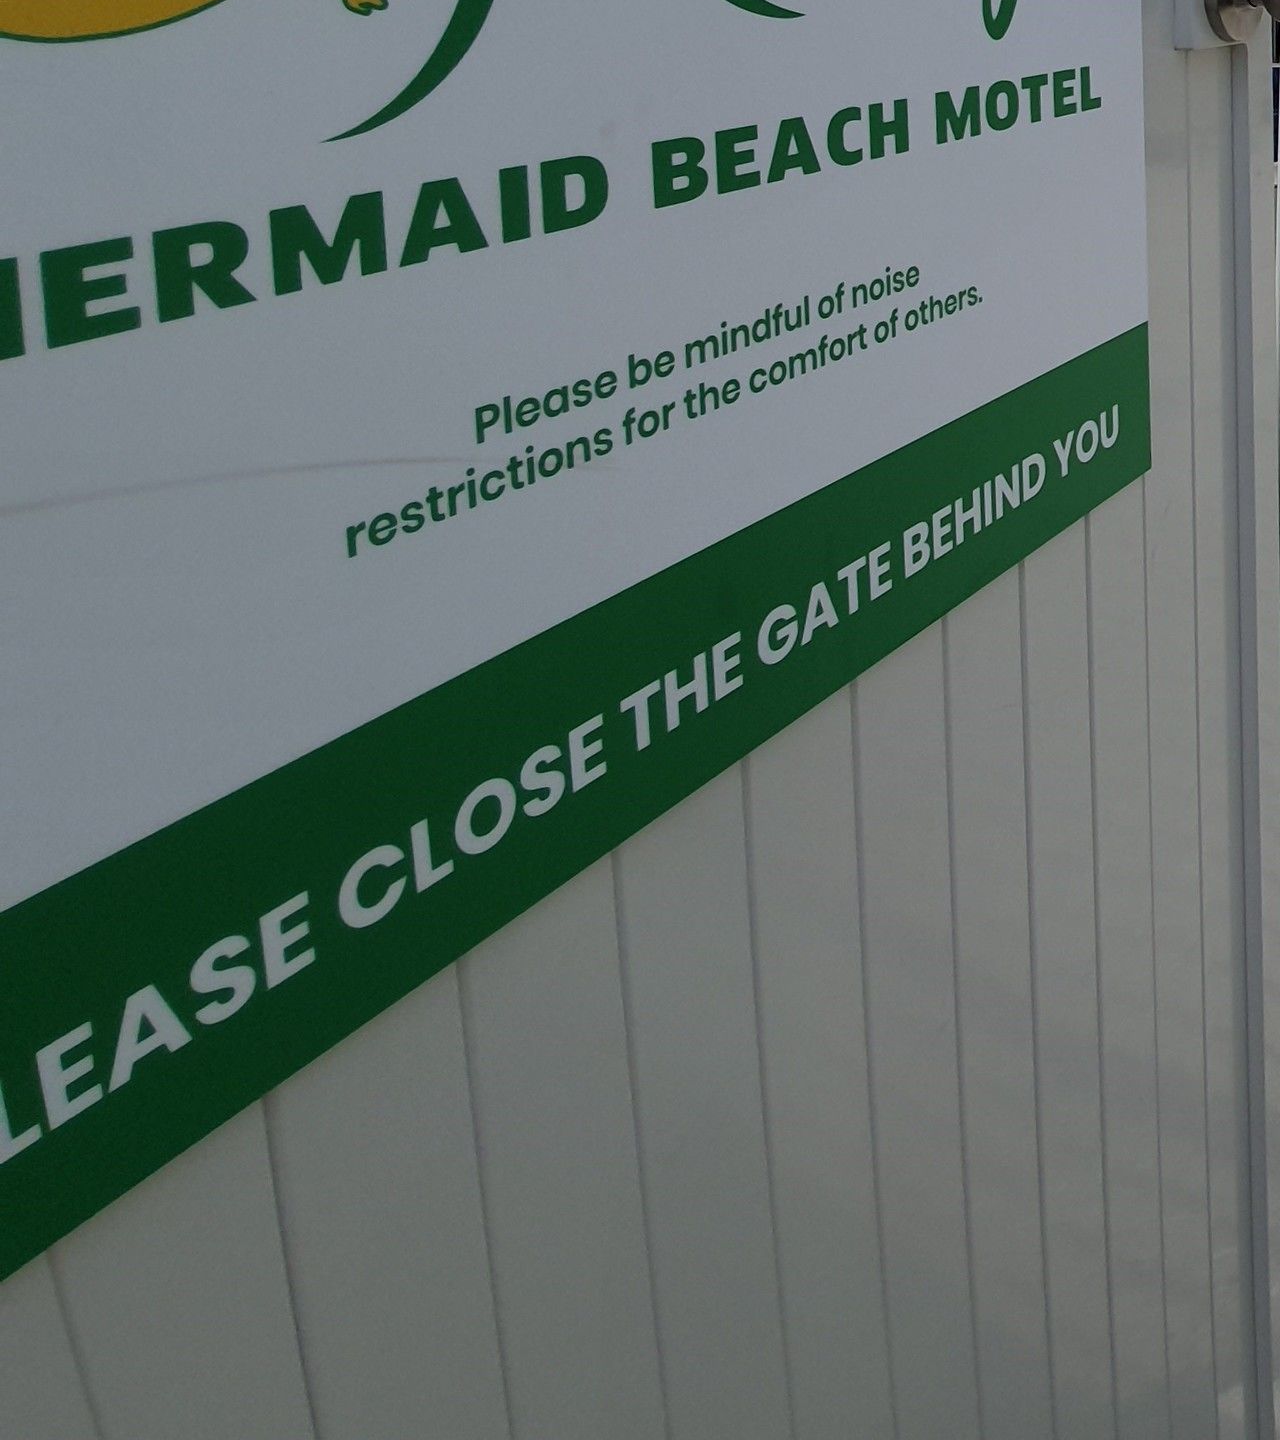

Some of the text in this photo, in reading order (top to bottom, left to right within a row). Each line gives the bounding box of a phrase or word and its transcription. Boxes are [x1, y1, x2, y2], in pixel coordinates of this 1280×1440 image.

[649, 98, 910, 210] BEACH
[933, 65, 1103, 146] MOTEL
[345, 285, 984, 559] restrictions for the comfort of others.
[474, 265, 920, 445] Please be mindful of noise
[337, 712, 609, 930] CLOSE
[618, 629, 746, 753] THE
[756, 539, 894, 667] GATE
[902, 451, 1048, 580] BEHIND
[1051, 402, 1121, 479] YOU
